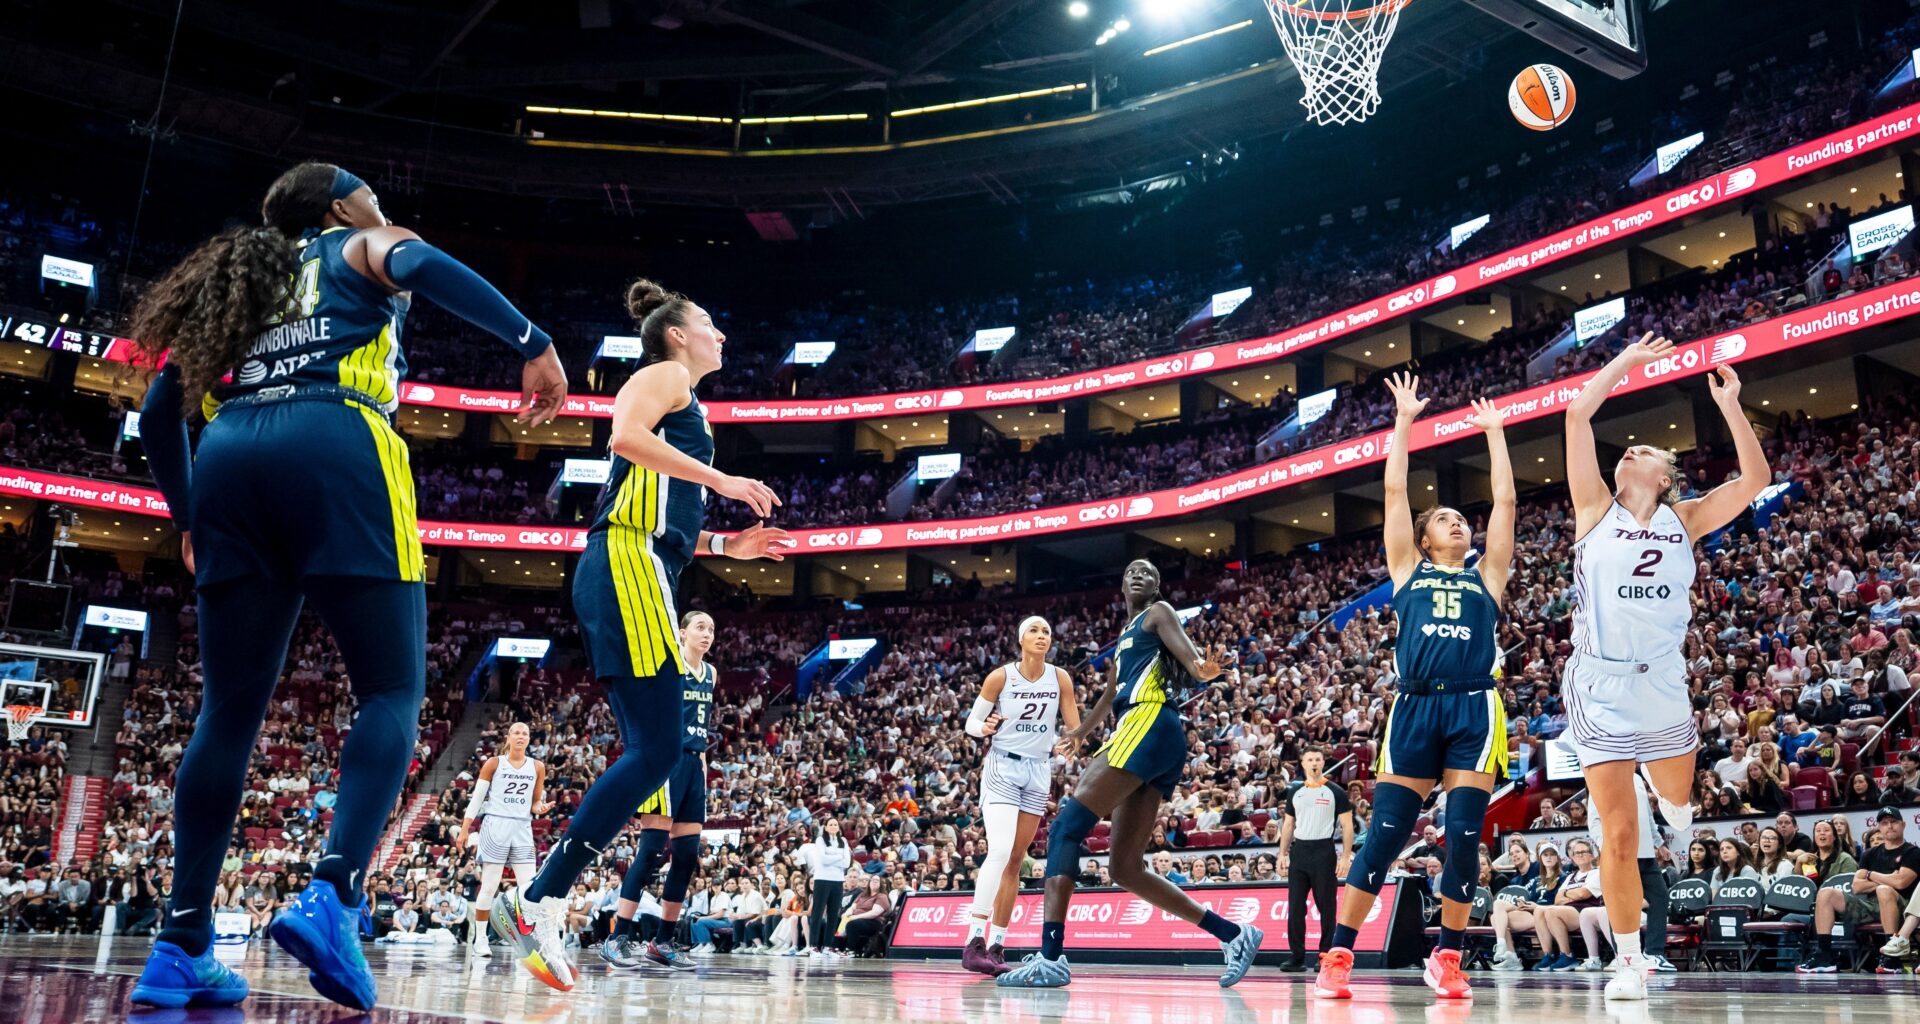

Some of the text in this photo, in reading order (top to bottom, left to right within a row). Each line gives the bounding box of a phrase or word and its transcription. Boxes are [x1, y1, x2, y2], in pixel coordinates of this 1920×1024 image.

[1540, 65, 1561, 101] Wilson
[1788, 118, 1912, 170] Founding partner
[1667, 190, 1699, 212] CIBC
[1479, 211, 1653, 279] Founding partner of the Tempo
[1858, 228, 1907, 248] CANADA
[1388, 292, 1413, 311] CIBC
[14, 322, 46, 344] 42
[1783, 309, 1859, 340] Founding
[63, 331, 100, 345] FTS 3
[1238, 309, 1378, 359] Founding partner of the Tempo
[88, 345, 98, 356] 5
[1145, 362, 1171, 377] CIBC
[1645, 354, 1680, 378] CIBC
[986, 372, 1135, 400] Founding partner of the Tempo
[460, 394, 509, 409] Founding
[567, 401, 584, 411] the
[895, 397, 920, 409] CIBC
[1542, 391, 1555, 407] of
[1558, 387, 1579, 403] the
[732, 403, 884, 418] Founding partner of the Tempo
[1334, 445, 1361, 464] CIBC
[1178, 460, 1323, 507] Founding partner of the Tempo
[46, 485, 98, 499] partner
[101, 491, 116, 502] of
[119, 494, 140, 506] the
[145, 496, 170, 511] Tem
[1079, 506, 1106, 522] CIBC
[429, 528, 442, 538] of
[444, 529, 463, 540] the
[467, 530, 505, 543] Tempo
[907, 515, 1068, 540] Founding partner of the Tempo
[1616, 528, 1683, 543] TEMPO
[519, 532, 548, 544] CIBC
[809, 533, 836, 546] CIBC
[1632, 549, 1663, 577] 2
[1411, 578, 1482, 594] DALLAS
[1617, 585, 1654, 599] CIBC
[1432, 590, 1462, 619] 35
[1437, 624, 1471, 640] CVS
[683, 690, 713, 703] DALLA
[1012, 691, 1057, 699] TEMPO
[697, 704, 706, 724] 5
[1019, 703, 1047, 720] 21
[1016, 724, 1038, 732] CIBC
[504, 782, 529, 795] 22
[1669, 887, 1694, 900] CIBC
[1719, 887, 1745, 898] CIBC
[1774, 882, 1799, 896] CIBC
[908, 906, 933, 923] CIBC
[1067, 904, 1099, 922] CIBC
